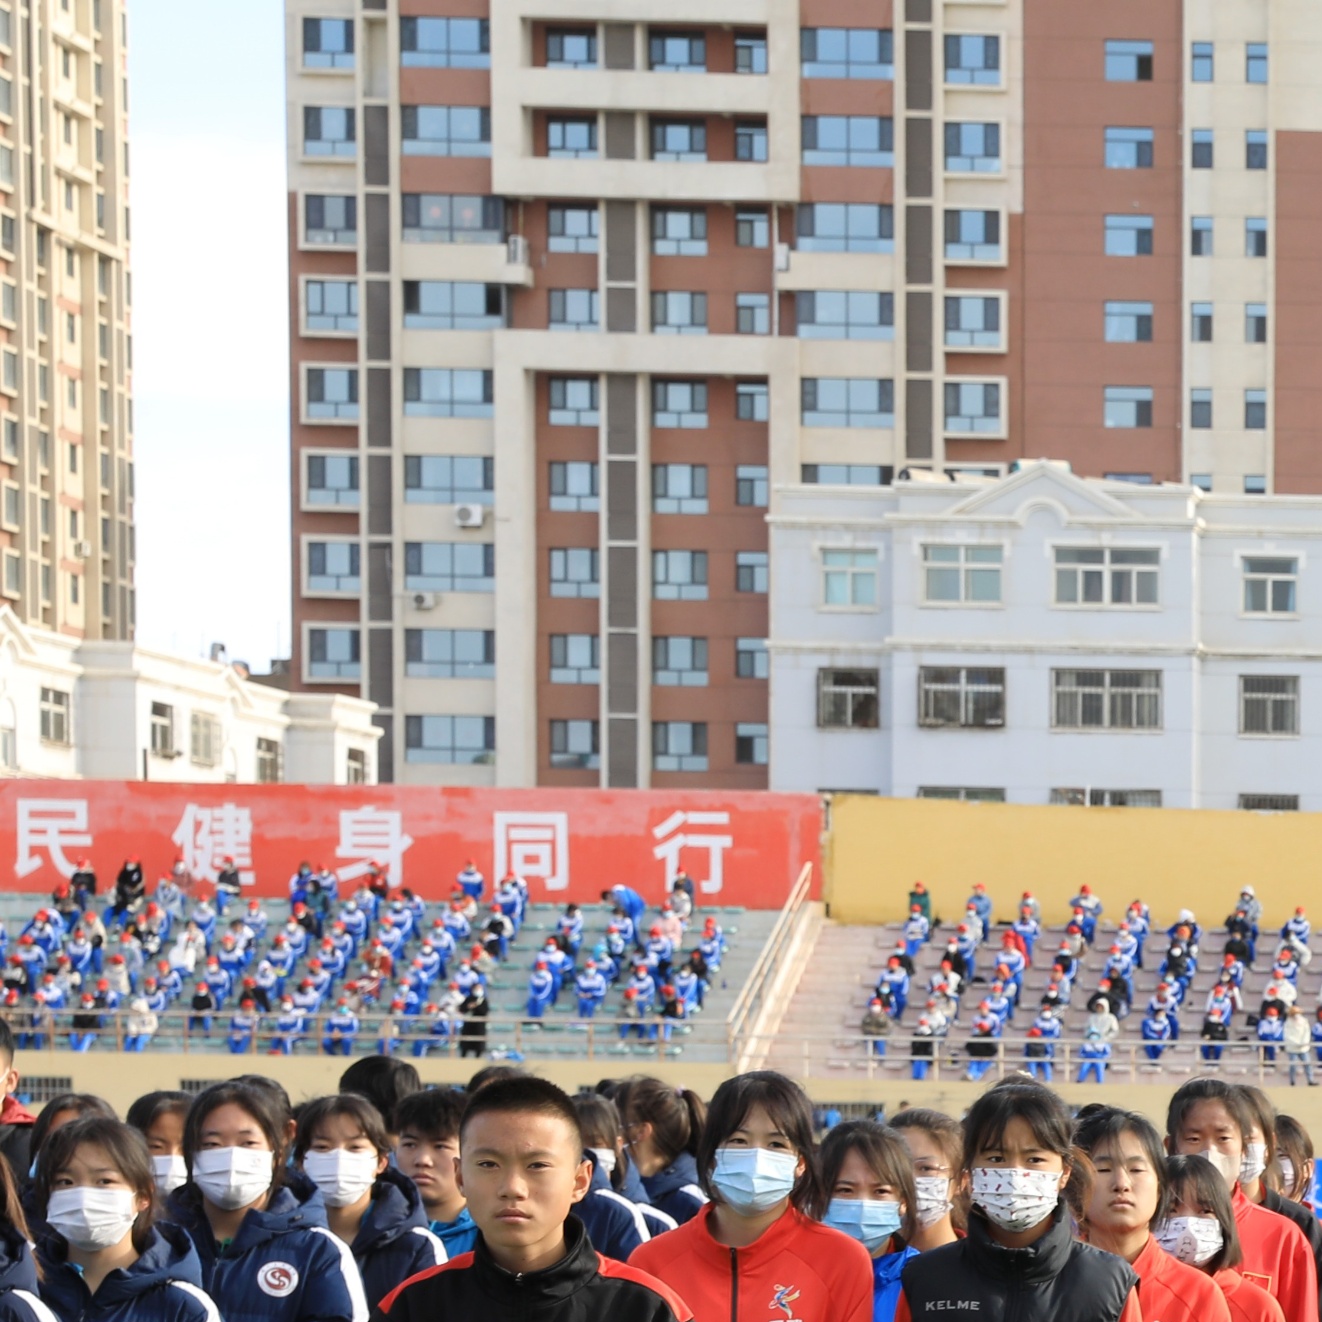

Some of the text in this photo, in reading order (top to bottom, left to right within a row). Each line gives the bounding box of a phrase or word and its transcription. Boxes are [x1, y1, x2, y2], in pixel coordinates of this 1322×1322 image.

[14, 797, 733, 894] 民健身同行
[925, 1299, 980, 1312] KELME
